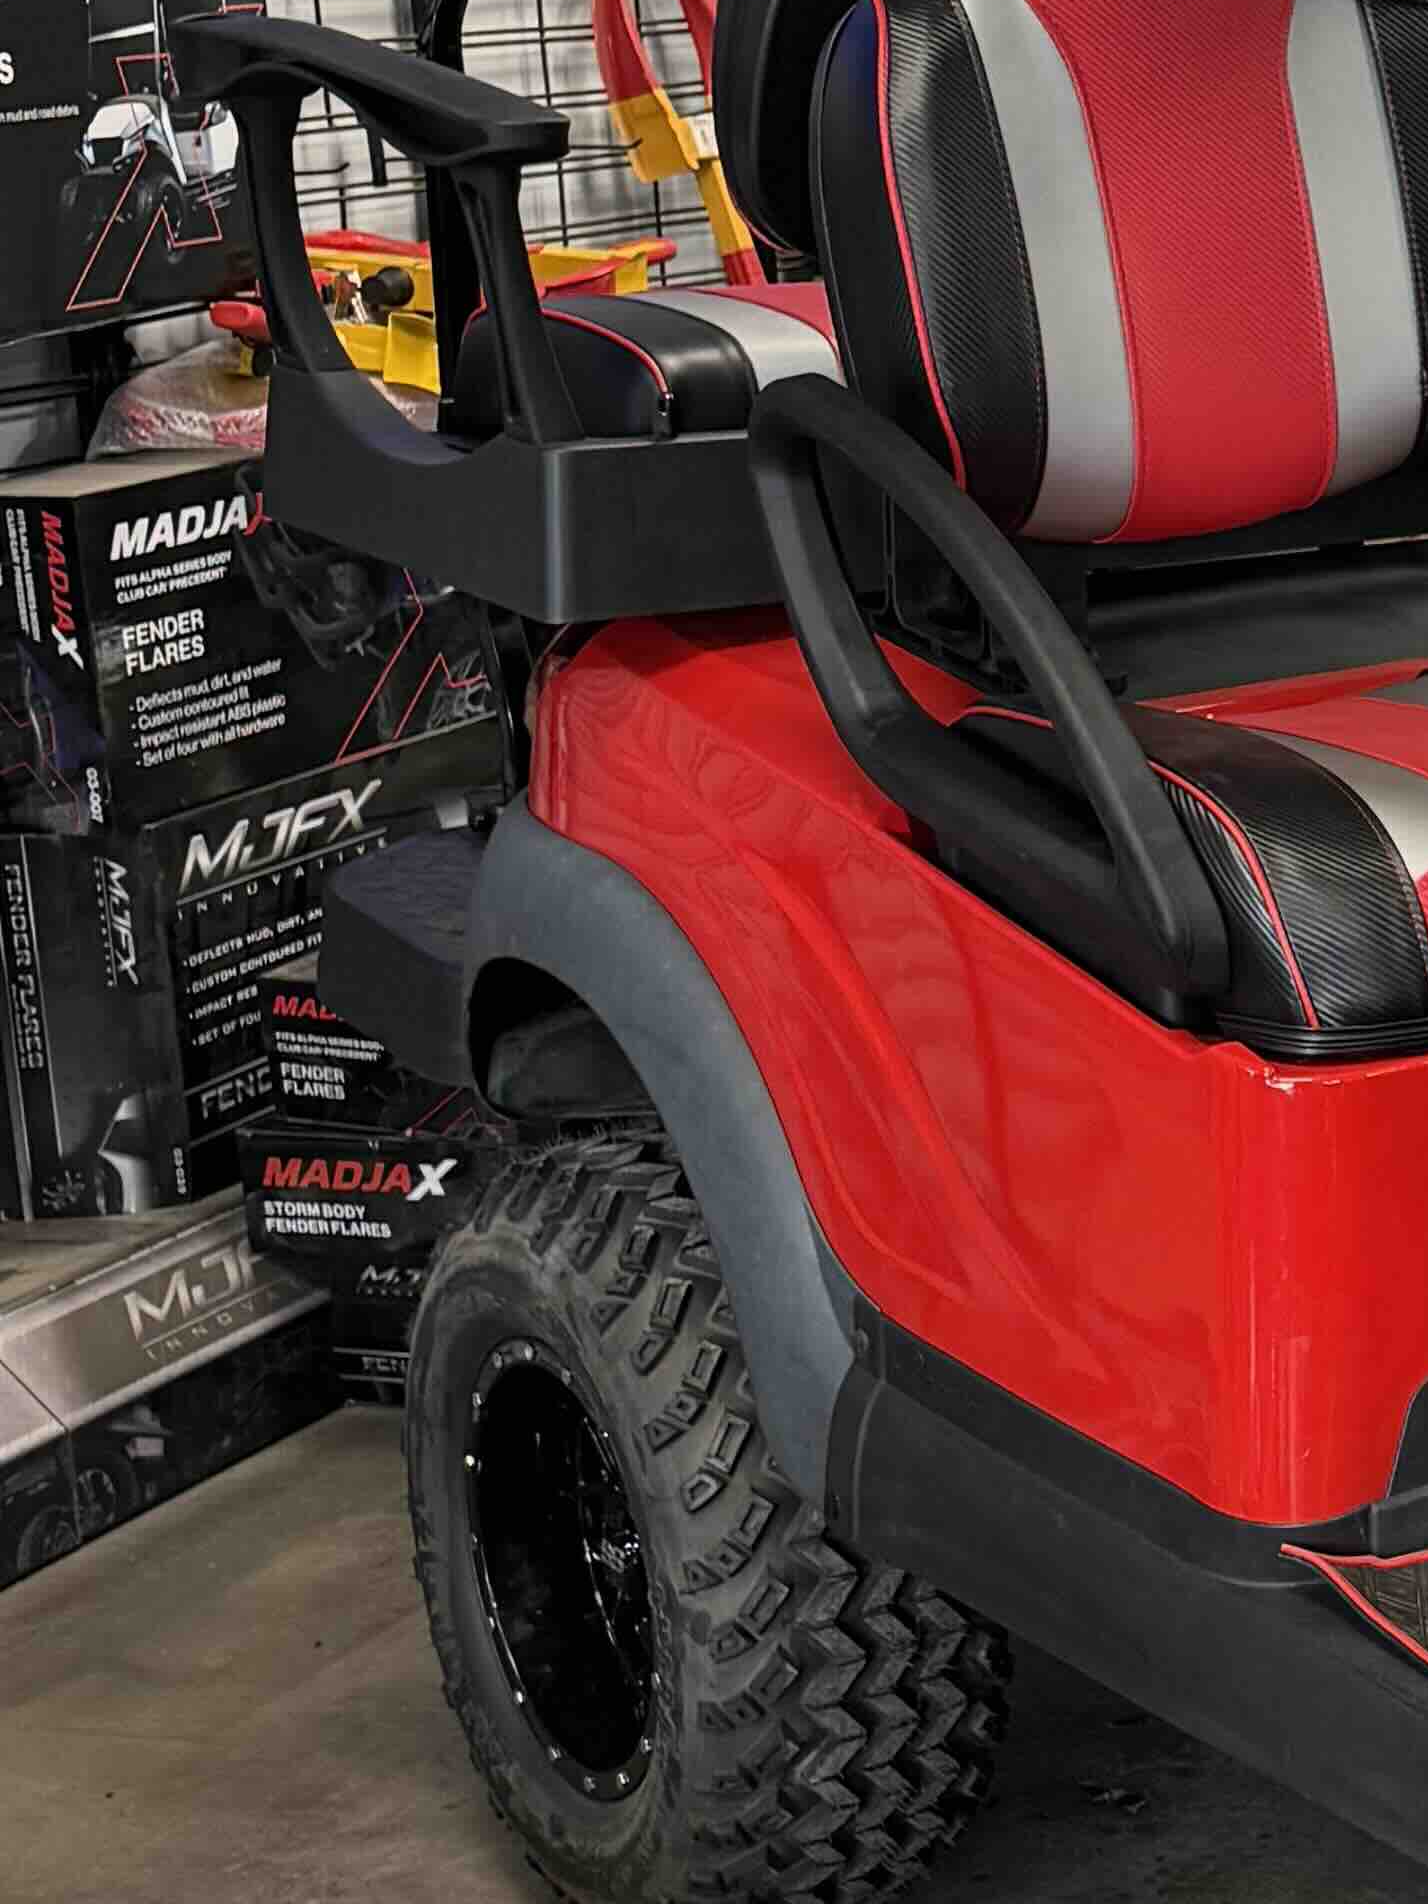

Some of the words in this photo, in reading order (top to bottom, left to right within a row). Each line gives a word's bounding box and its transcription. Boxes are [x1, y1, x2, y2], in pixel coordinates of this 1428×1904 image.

[41, 509, 84, 671] MADJAX
[117, 587, 145, 604] CLUB
[122, 607, 205, 650] FENDER
[125, 633, 205, 676] FLARES
[178, 778, 383, 896] MJFX
[4, 863, 32, 967] FENDER
[104, 857, 139, 985] MJFX
[236, 983, 259, 1002] RES
[17, 973, 44, 1069] FLARES
[239, 1009, 262, 1029] FOU
[280, 1061, 345, 1084] FENDER
[282, 1079, 346, 1100] FLARES
[262, 1156, 458, 1201] MADJAX
[263, 1199, 321, 1218] STORM
[322, 1202, 366, 1220] BODY
[265, 1217, 330, 1236] FENDER
[331, 1220, 393, 1239] FLARES
[122, 1237, 264, 1342] MJF
